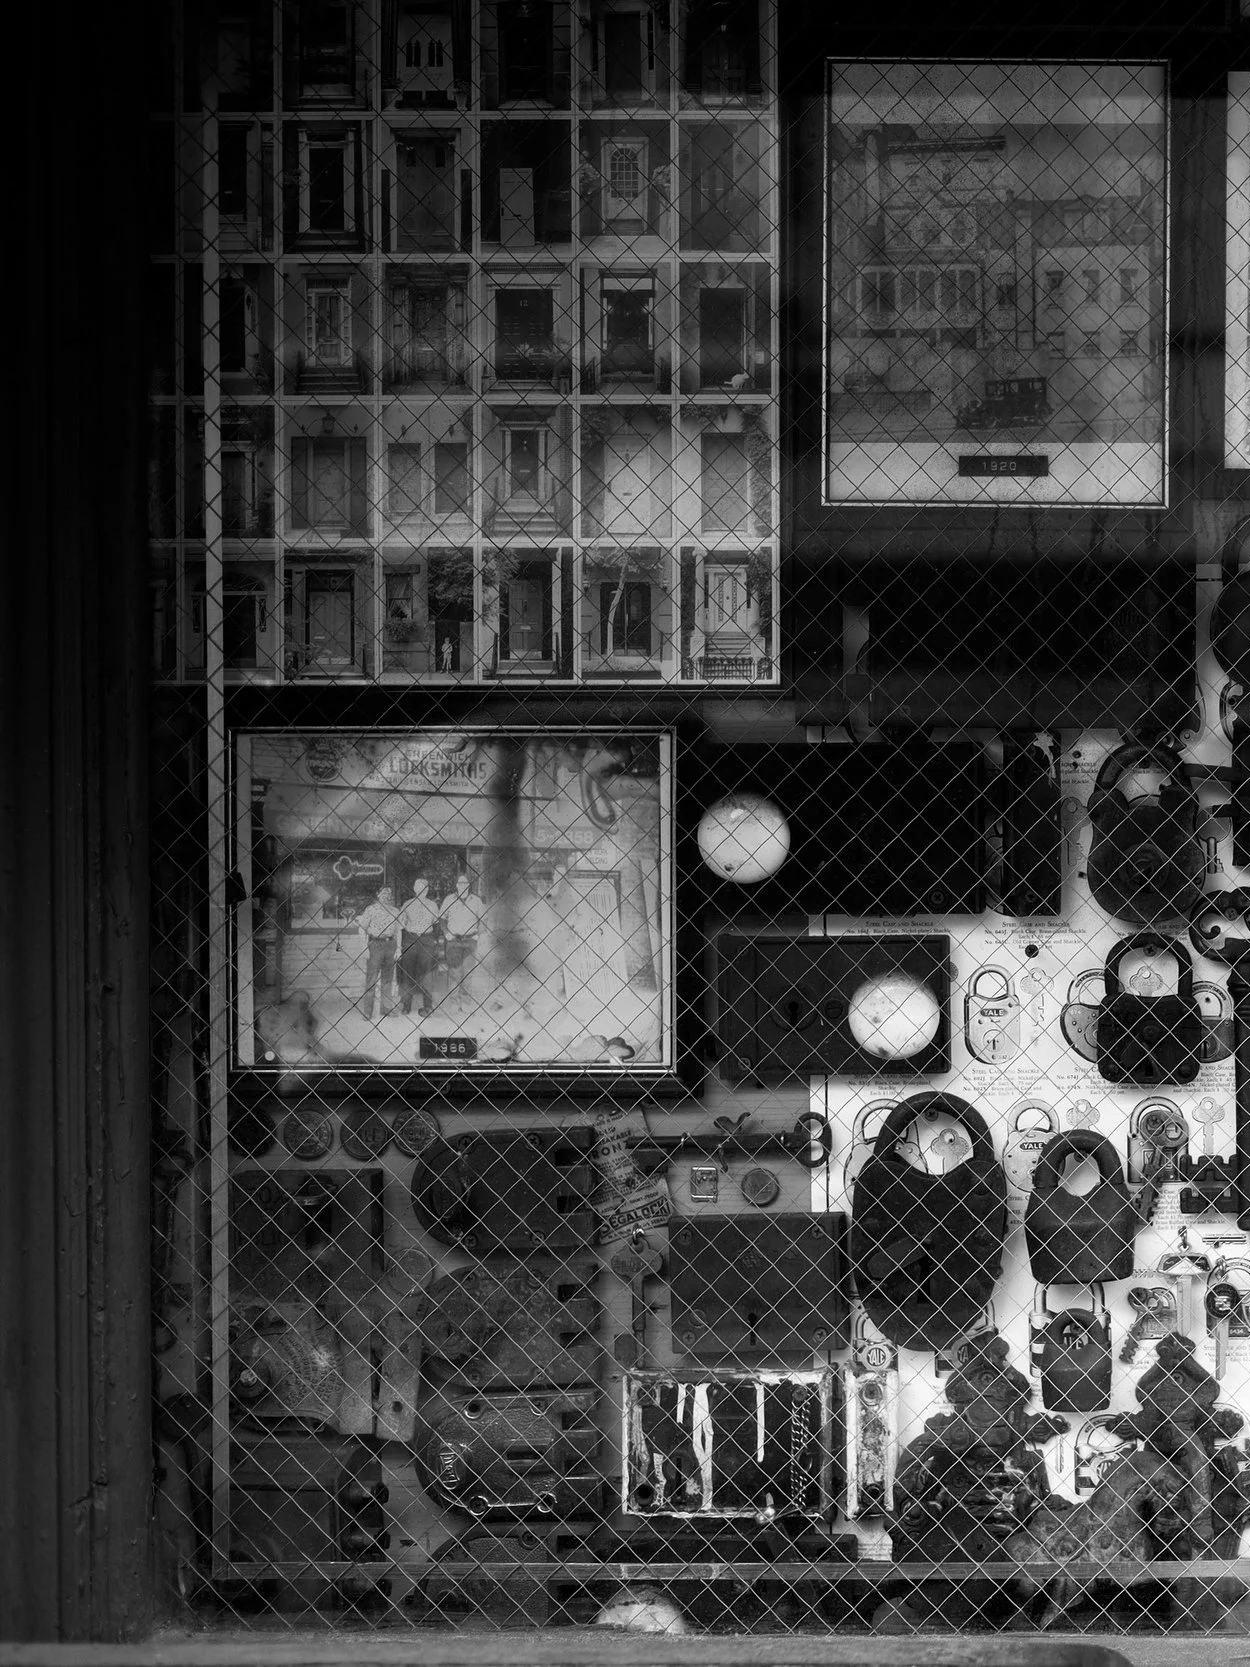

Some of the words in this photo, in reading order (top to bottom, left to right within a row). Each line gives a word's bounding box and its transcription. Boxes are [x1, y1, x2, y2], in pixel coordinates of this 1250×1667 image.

[981, 460, 1018, 472] 1920
[389, 758, 488, 781] LOCKSMITHS
[983, 1008, 1005, 1017] YALE
[434, 1042, 467, 1054] 1986
[867, 1350, 887, 1365] YALE
